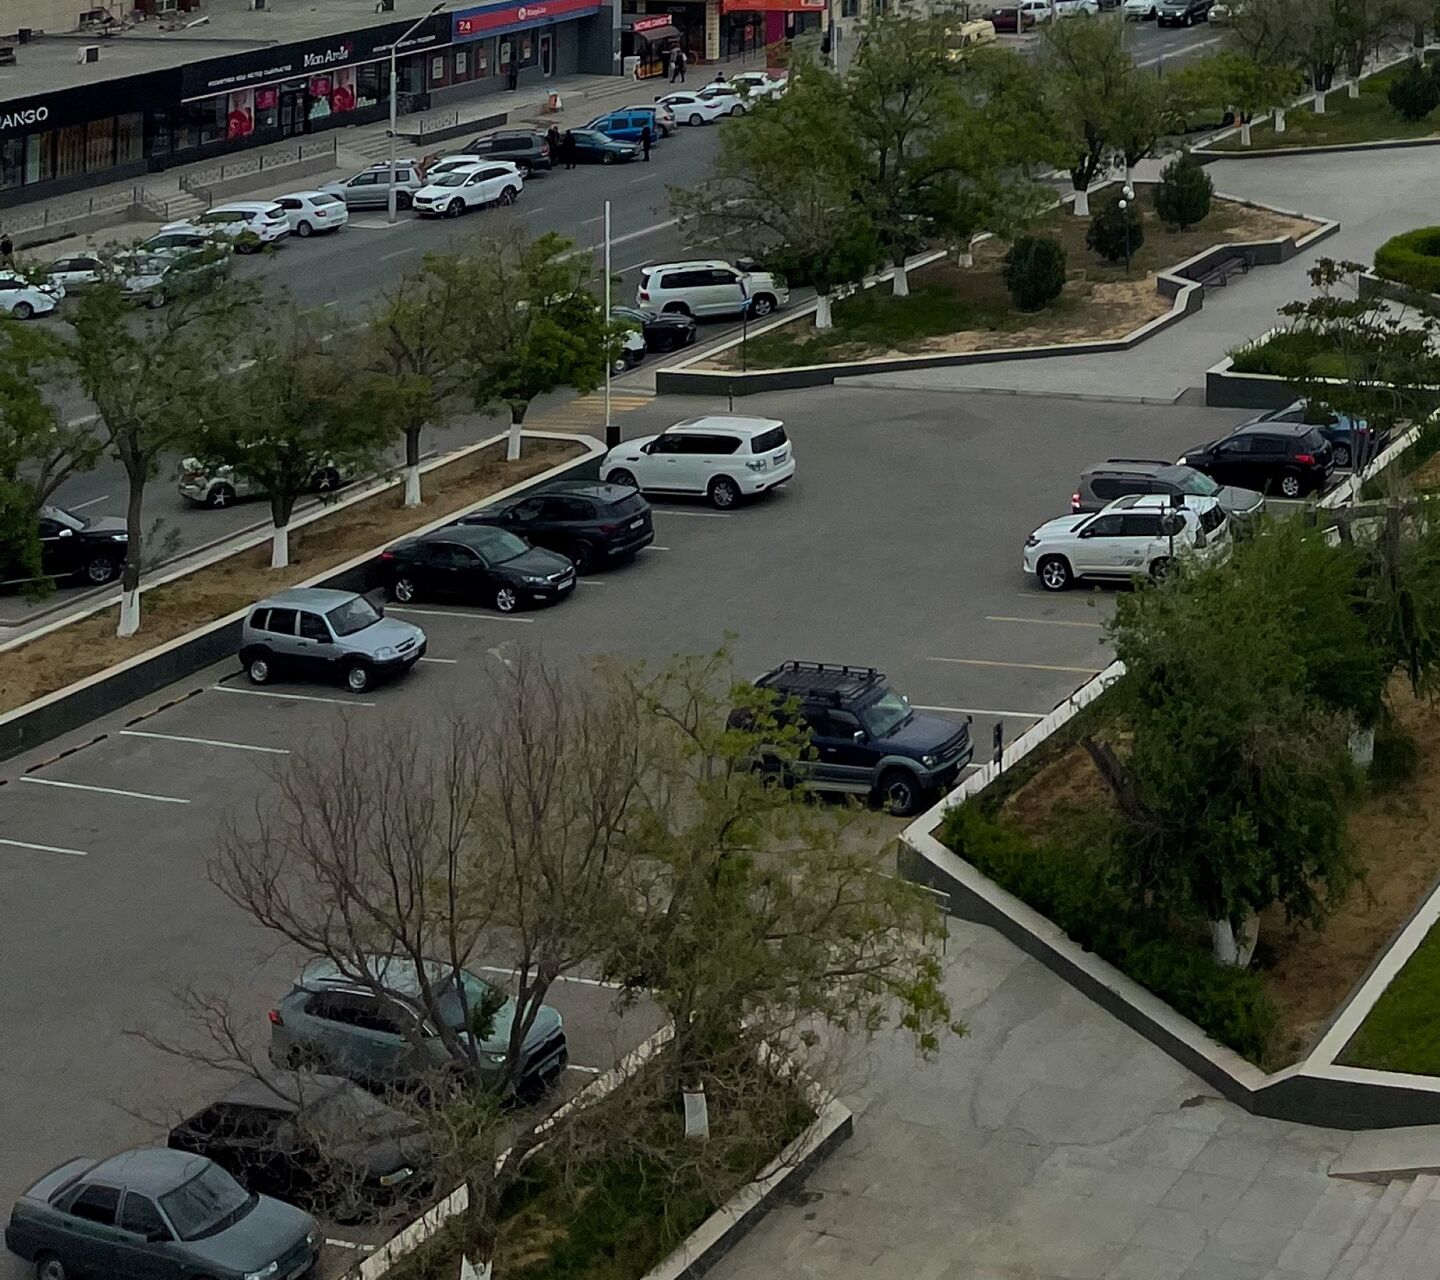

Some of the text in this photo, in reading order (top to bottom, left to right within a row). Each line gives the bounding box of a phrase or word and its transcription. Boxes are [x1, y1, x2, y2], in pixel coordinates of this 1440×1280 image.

[459, 20, 471, 30] 24
[303, 53, 324, 67] Mon
[0, 106, 48, 130] ANGO
